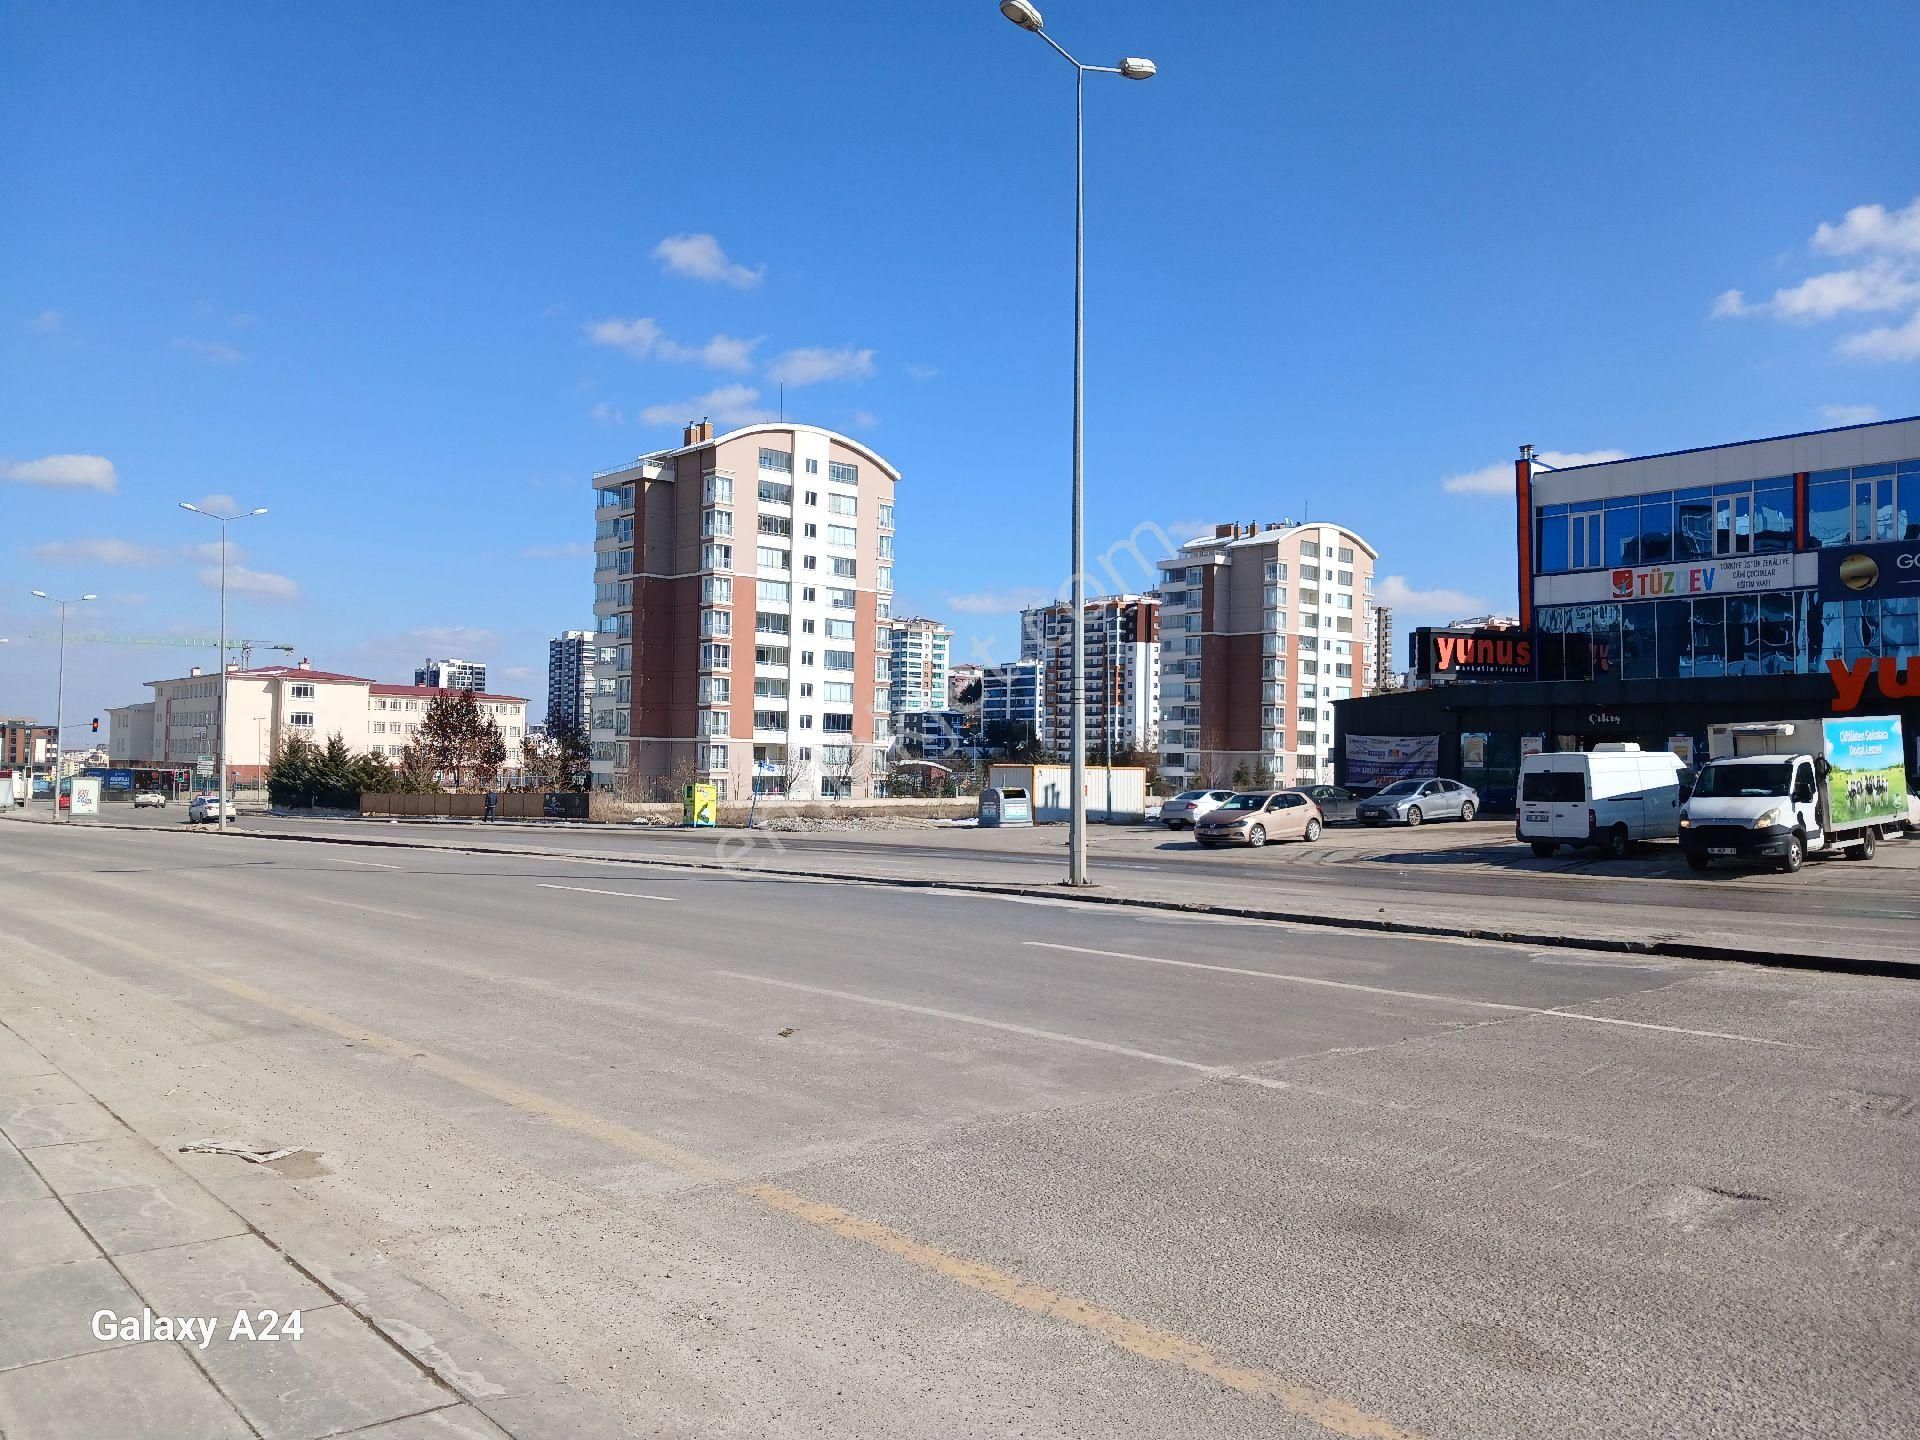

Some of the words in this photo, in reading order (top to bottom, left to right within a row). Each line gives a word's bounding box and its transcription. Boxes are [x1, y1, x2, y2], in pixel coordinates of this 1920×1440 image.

[1720, 561, 1742, 570] TÜRKİYE
[1746, 569, 1776, 579] ÇOCUKLAR
[1637, 567, 1715, 596] TÜZDEV
[1736, 580, 1755, 589] EĞİTİM
[1755, 579, 1771, 587] VAKFI
[1436, 637, 1531, 670] yunus
